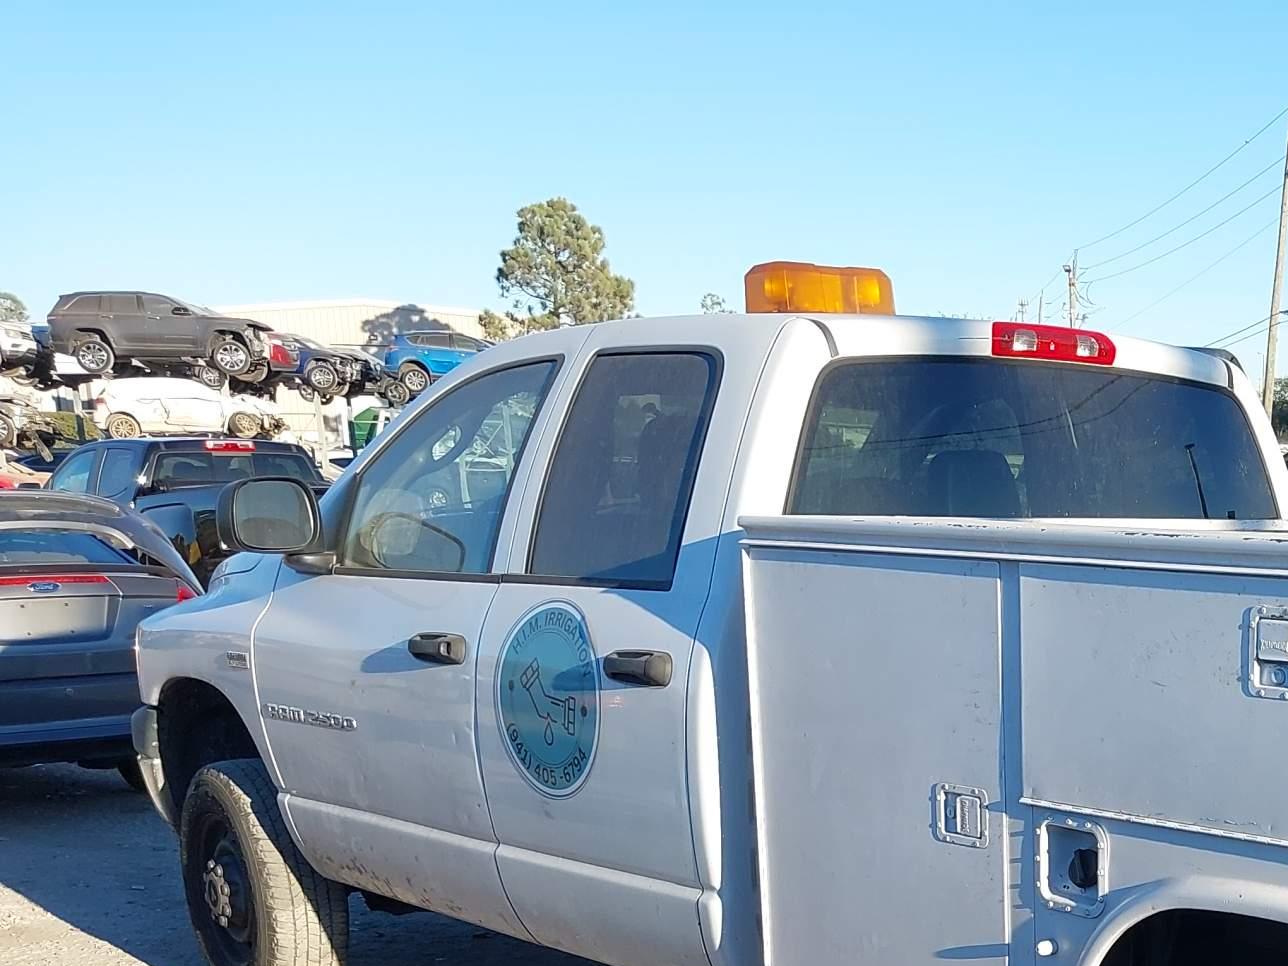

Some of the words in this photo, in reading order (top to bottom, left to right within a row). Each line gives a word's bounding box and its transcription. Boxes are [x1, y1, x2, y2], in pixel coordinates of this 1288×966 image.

[512, 619, 542, 656] H.I.M.
[544, 611, 594, 677] IRRIGATION
[266, 703, 305, 723] RAM
[306, 710, 358, 731] 2500
[506, 722, 532, 770] (941)
